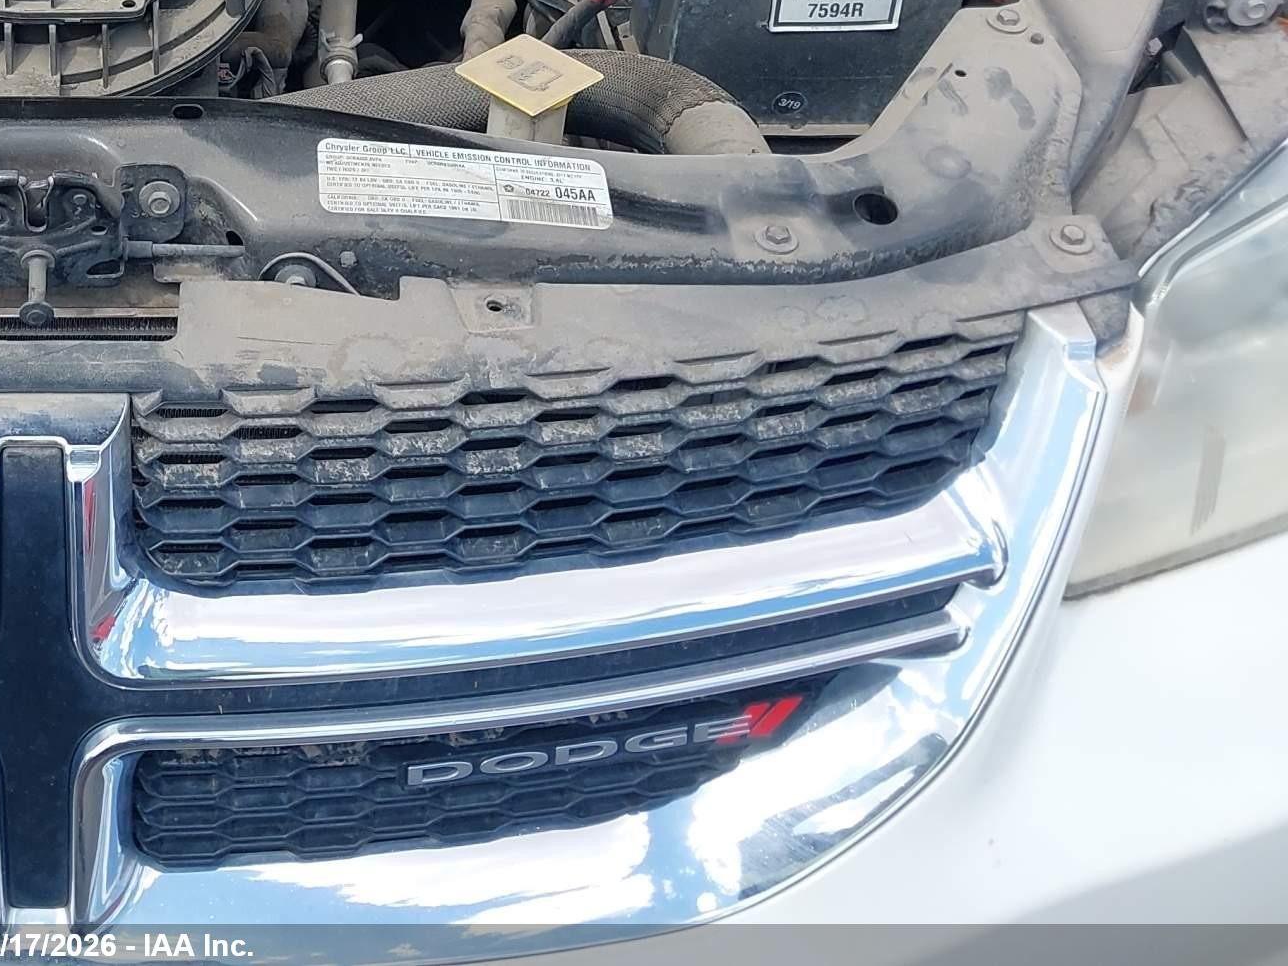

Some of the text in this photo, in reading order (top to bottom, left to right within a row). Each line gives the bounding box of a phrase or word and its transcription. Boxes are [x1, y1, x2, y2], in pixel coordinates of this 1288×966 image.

[807, 2, 864, 18] 7594R
[777, 98, 801, 110] 3/19
[325, 142, 359, 153] Chrysler
[362, 145, 388, 155] Group
[415, 149, 591, 171] VEHICLE EMISSION CONTROL INFORMATION
[525, 186, 596, 202] 04722 045AA
[407, 714, 753, 786] DODGE
